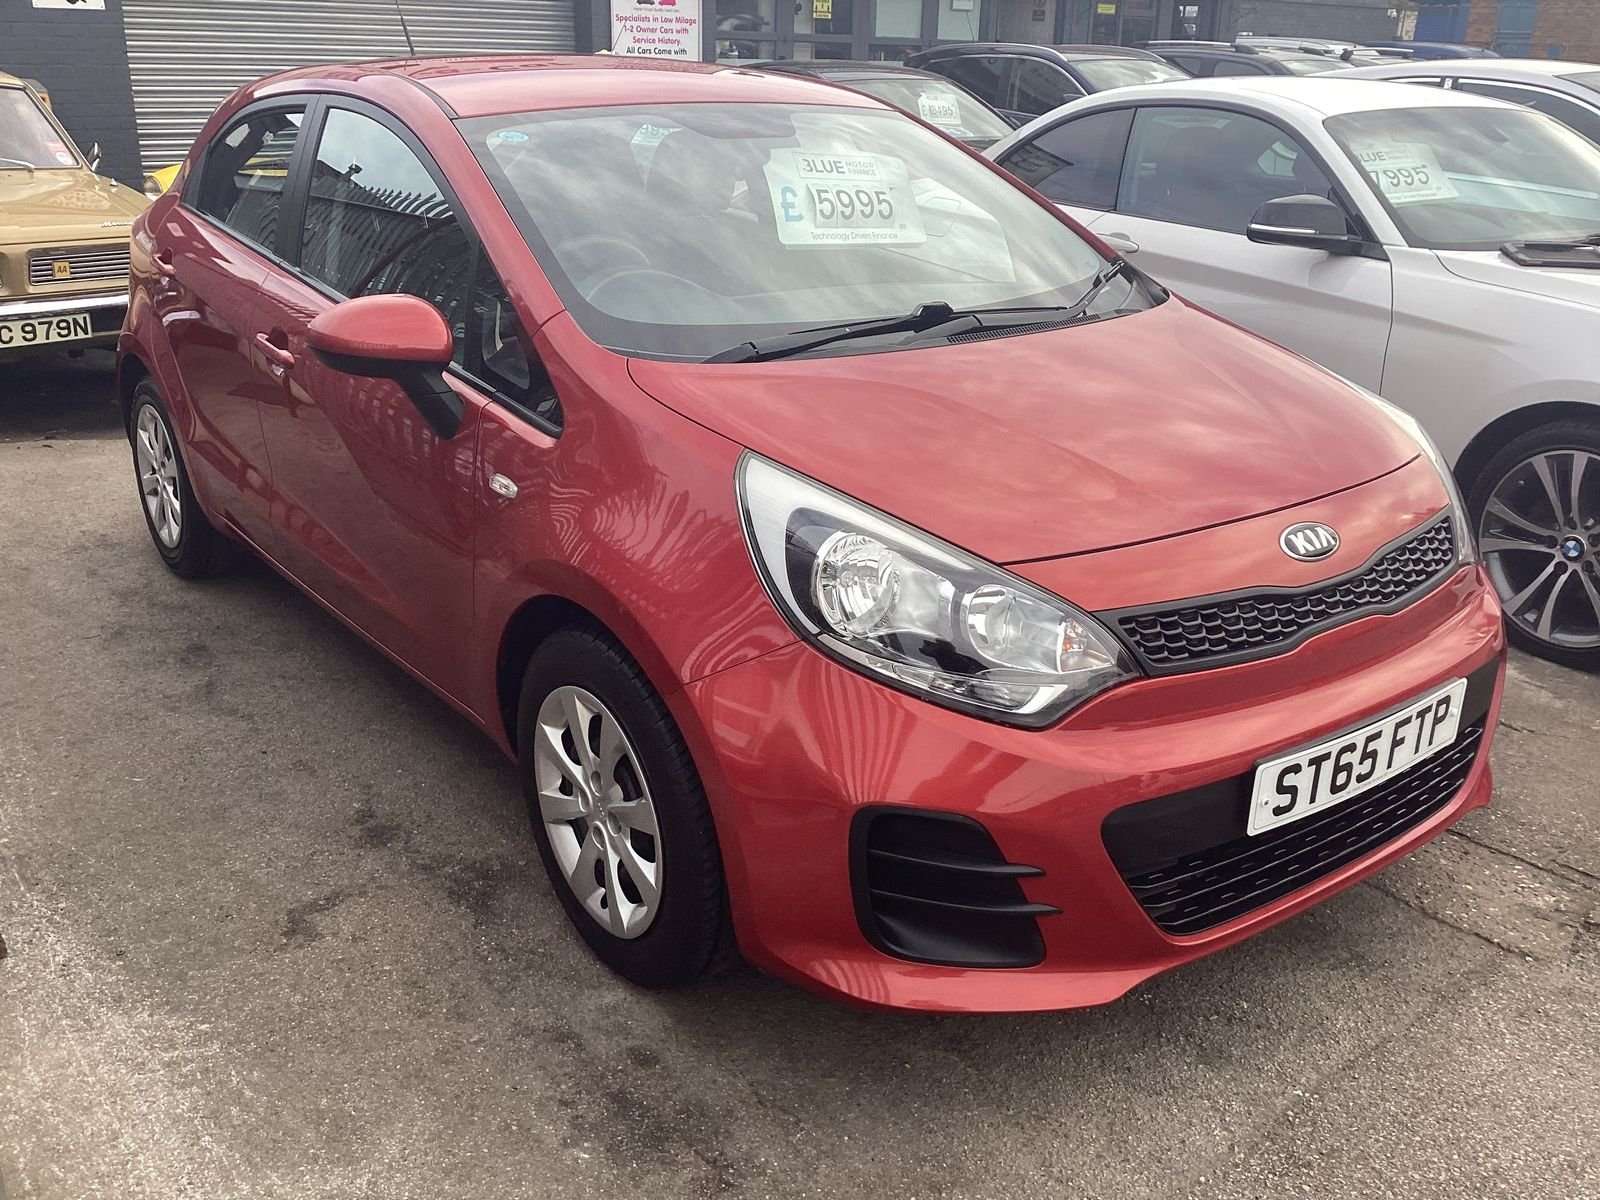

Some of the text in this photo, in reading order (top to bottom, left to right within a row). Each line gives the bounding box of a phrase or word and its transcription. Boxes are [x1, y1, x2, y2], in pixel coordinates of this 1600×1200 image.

[615, 14, 650, 24] Specialists
[675, 17, 697, 26] Milage
[636, 25, 658, 33] Owner
[660, 26, 673, 34] Cars
[632, 36, 681, 46] Service History
[626, 46, 636, 54] All
[637, 47, 652, 55] Cars
[654, 47, 672, 55] Come
[810, 231, 850, 241] Technology
[20, 315, 90, 342] 979N
[1287, 526, 1336, 555] KIA
[1272, 694, 1452, 817] ST65 FTP
